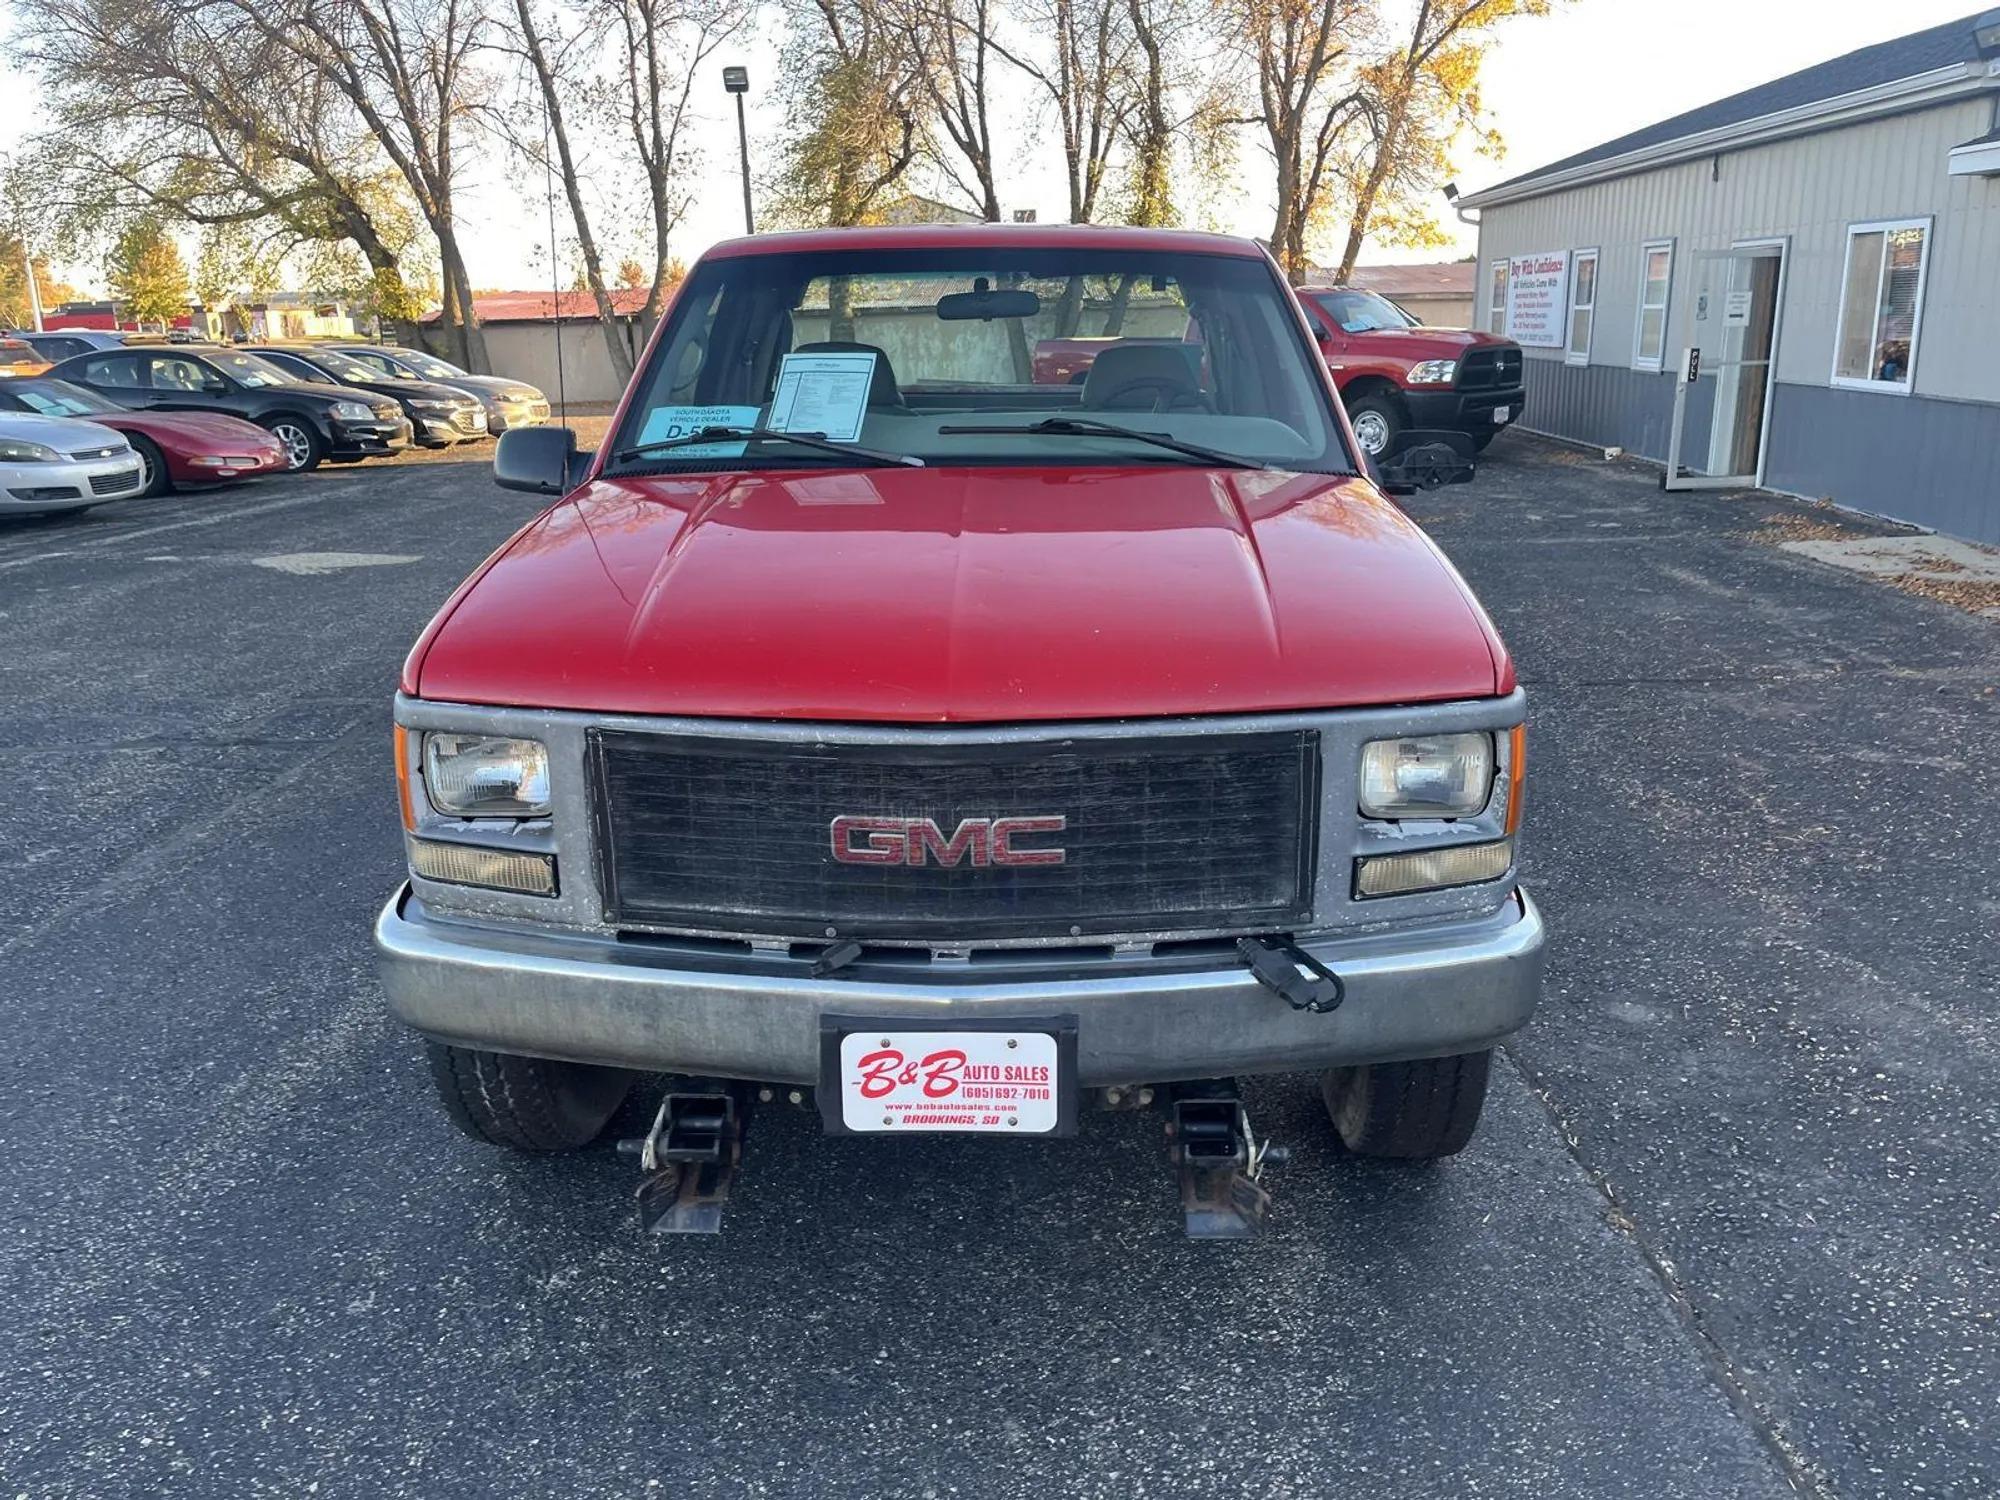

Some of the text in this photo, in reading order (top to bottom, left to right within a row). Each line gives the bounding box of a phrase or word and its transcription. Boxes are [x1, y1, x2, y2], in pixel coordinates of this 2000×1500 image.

[1534, 257, 1563, 274] Confidence
[1689, 351, 1699, 380] PULL
[831, 815, 1066, 867] GMC
[857, 1049, 967, 1099] B&B
[963, 1065, 1049, 1082] AUTO SALES
[902, 1114, 1001, 1126] BROOKINGS, SD
